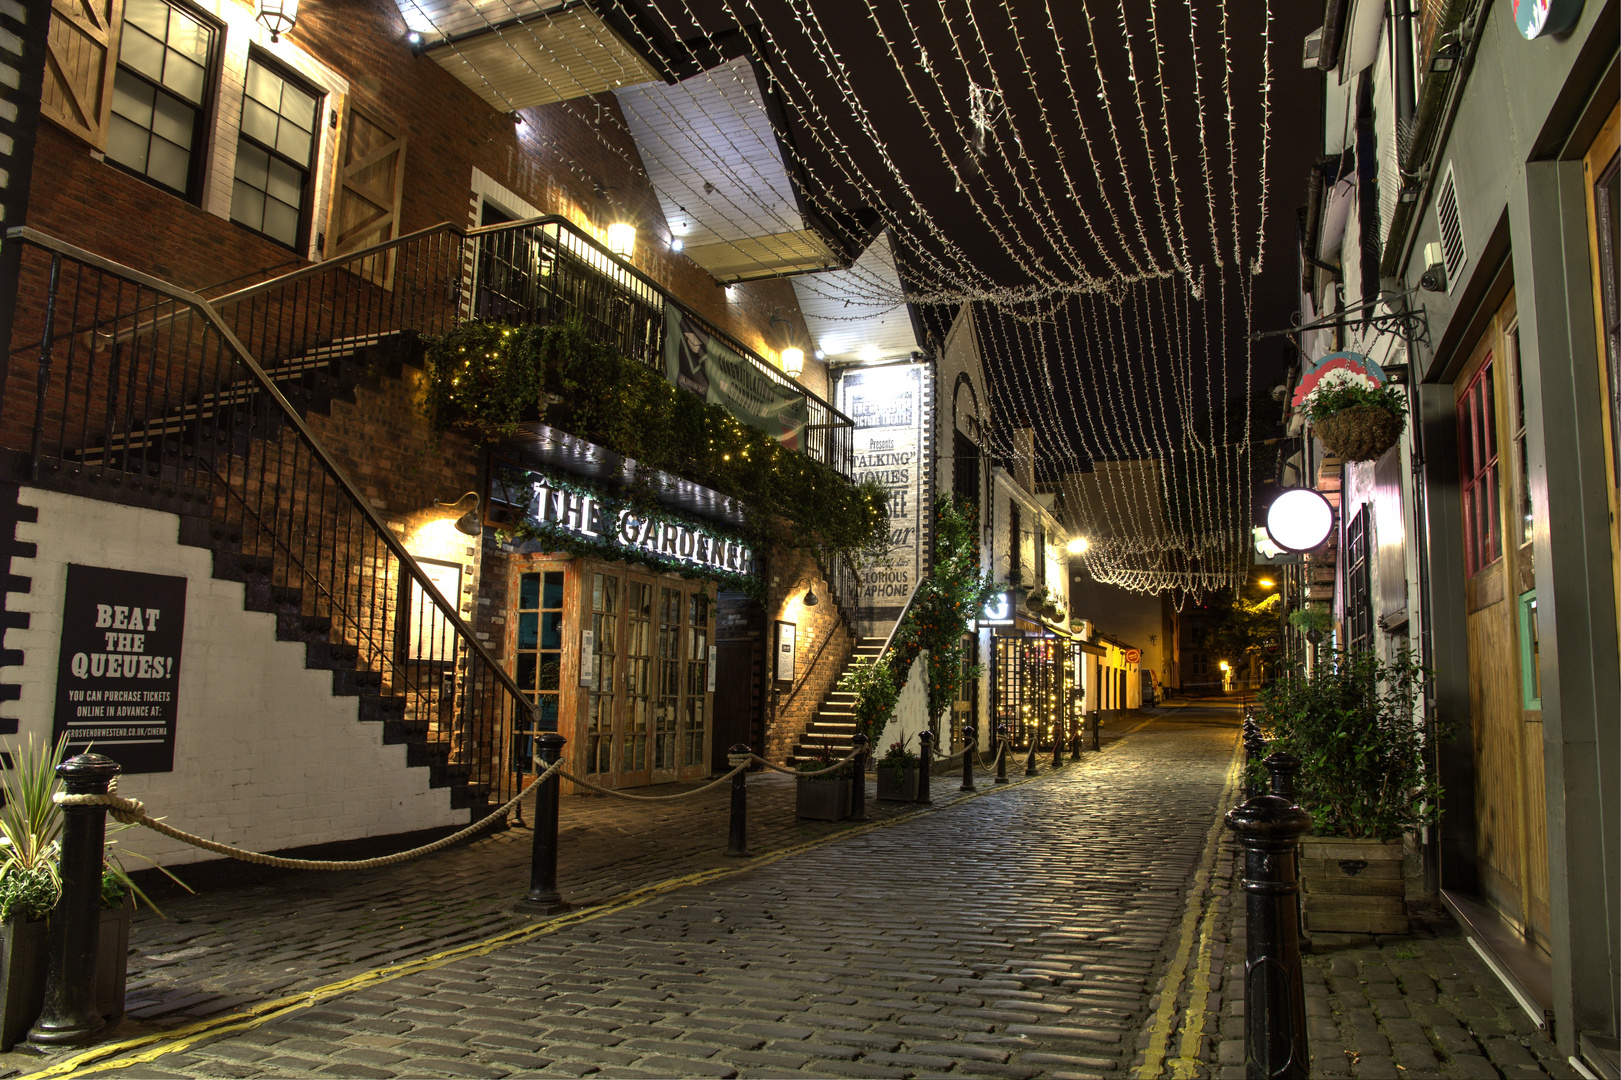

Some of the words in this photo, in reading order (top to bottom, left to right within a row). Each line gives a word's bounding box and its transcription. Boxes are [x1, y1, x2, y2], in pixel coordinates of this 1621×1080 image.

[870, 438, 894, 449] Presents
[532, 481, 601, 537] THE
[616, 508, 752, 575] GARDENER
[95, 604, 160, 631] BEAT
[105, 632, 145, 652] THE
[71, 652, 173, 679] QUEUES!
[69, 690, 84, 702] YOU
[86, 690, 102, 702] CAN
[104, 691, 141, 702] PURCHASE
[143, 691, 171, 702] TICKETS
[77, 706, 104, 717] ONLINE
[106, 706, 115, 717] IN
[116, 706, 149, 717] ADVANCE
[150, 706, 162, 717] AT:
[67, 727, 167, 738] GROSVENORWESTEND.CO.UK/CINEMA
